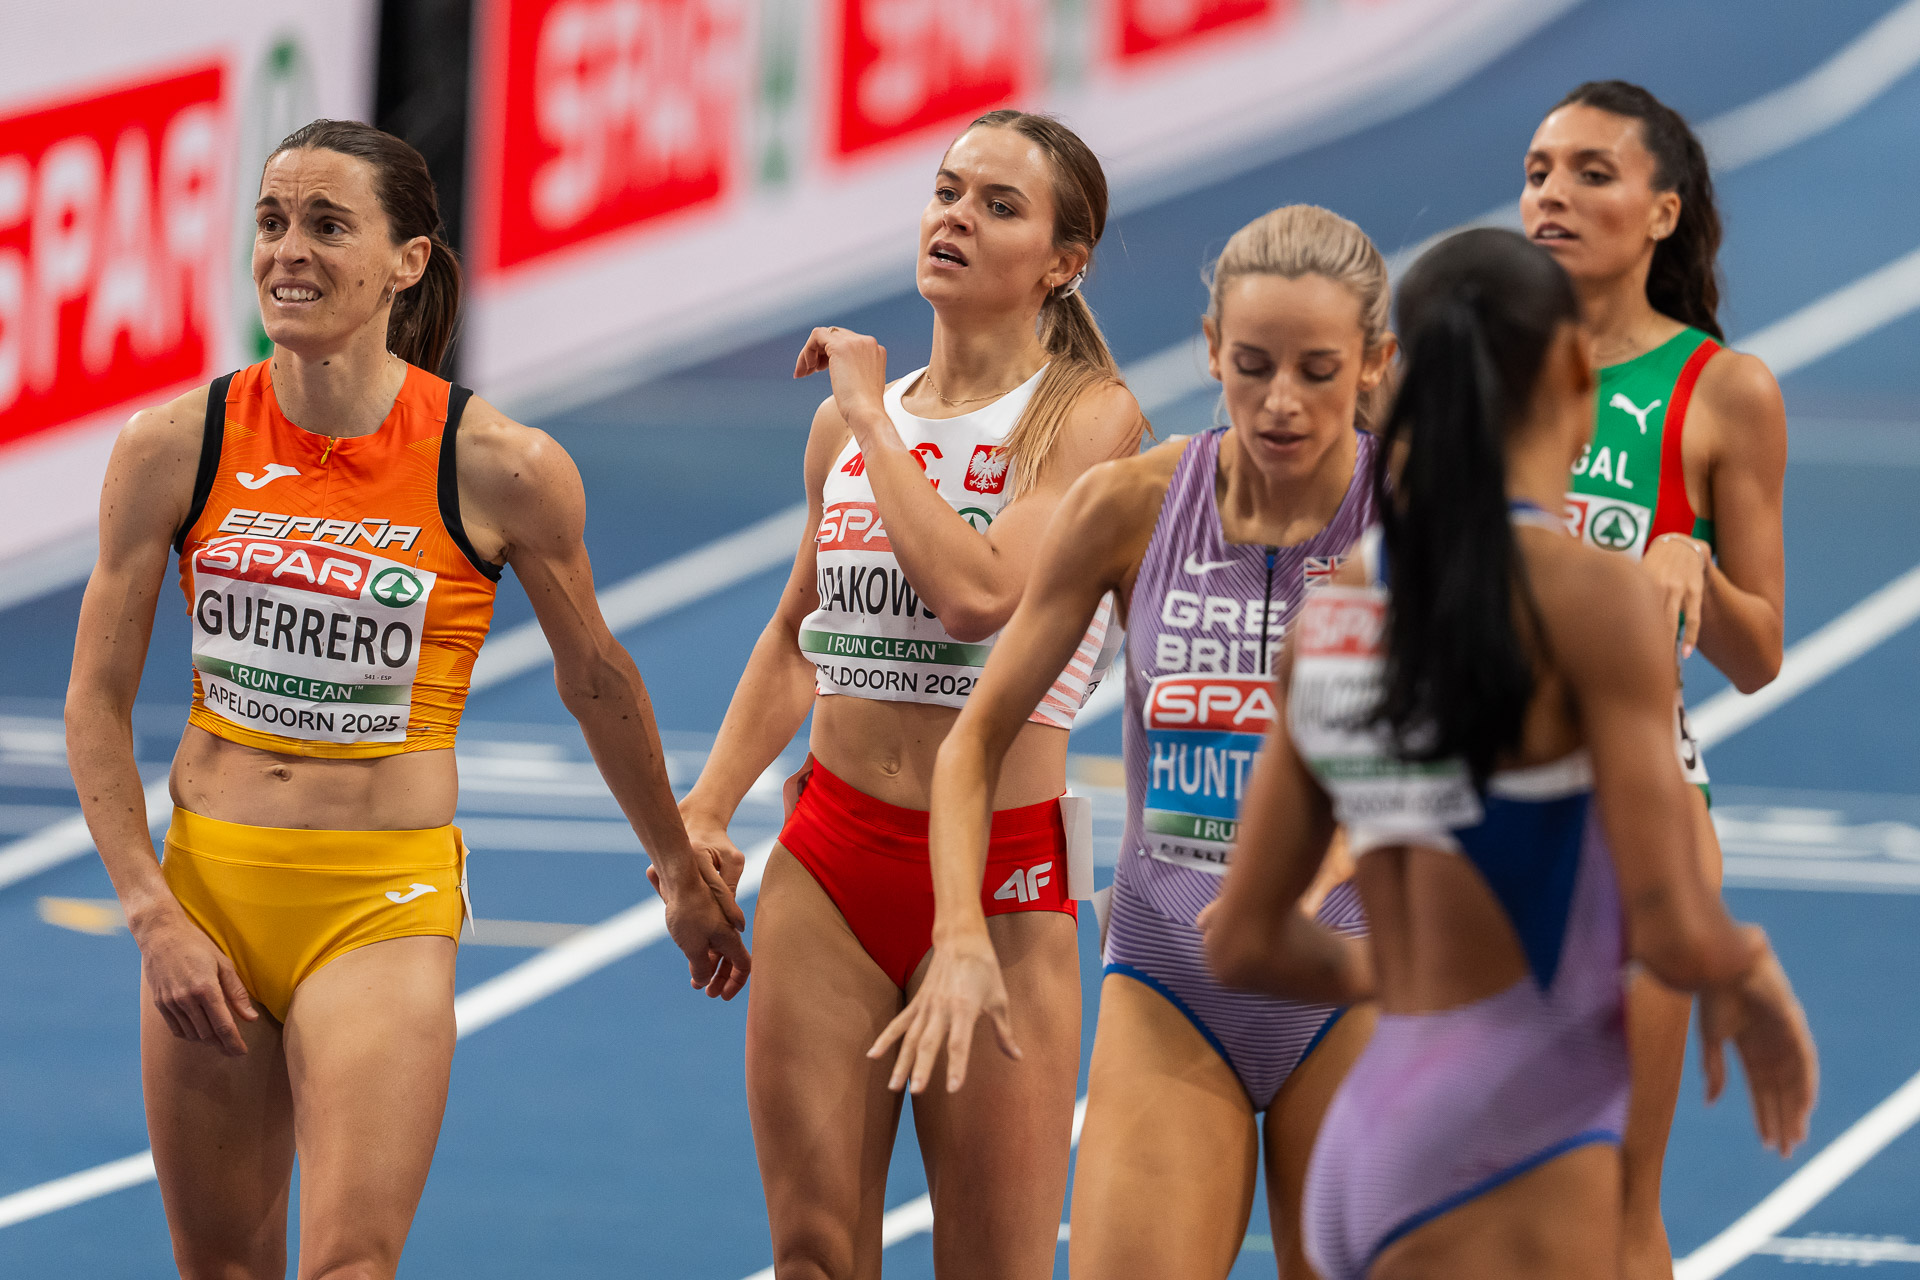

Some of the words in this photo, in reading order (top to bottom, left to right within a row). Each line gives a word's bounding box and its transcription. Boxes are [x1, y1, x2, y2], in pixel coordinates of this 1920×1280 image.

[217, 507, 422, 551] ESPAÑA
[200, 541, 366, 591] SPAR
[196, 589, 413, 668] GUERRERO
[827, 635, 833, 652] I
[834, 636, 867, 655] RUN
[229, 665, 236, 681] I
[236, 667, 279, 696] RUN
[208, 682, 334, 733] APELDOORN
[341, 713, 401, 734] 2025
[1152, 742, 1261, 801] HUNT
[1194, 818, 1201, 837] I
[993, 860, 1053, 903] 4F
